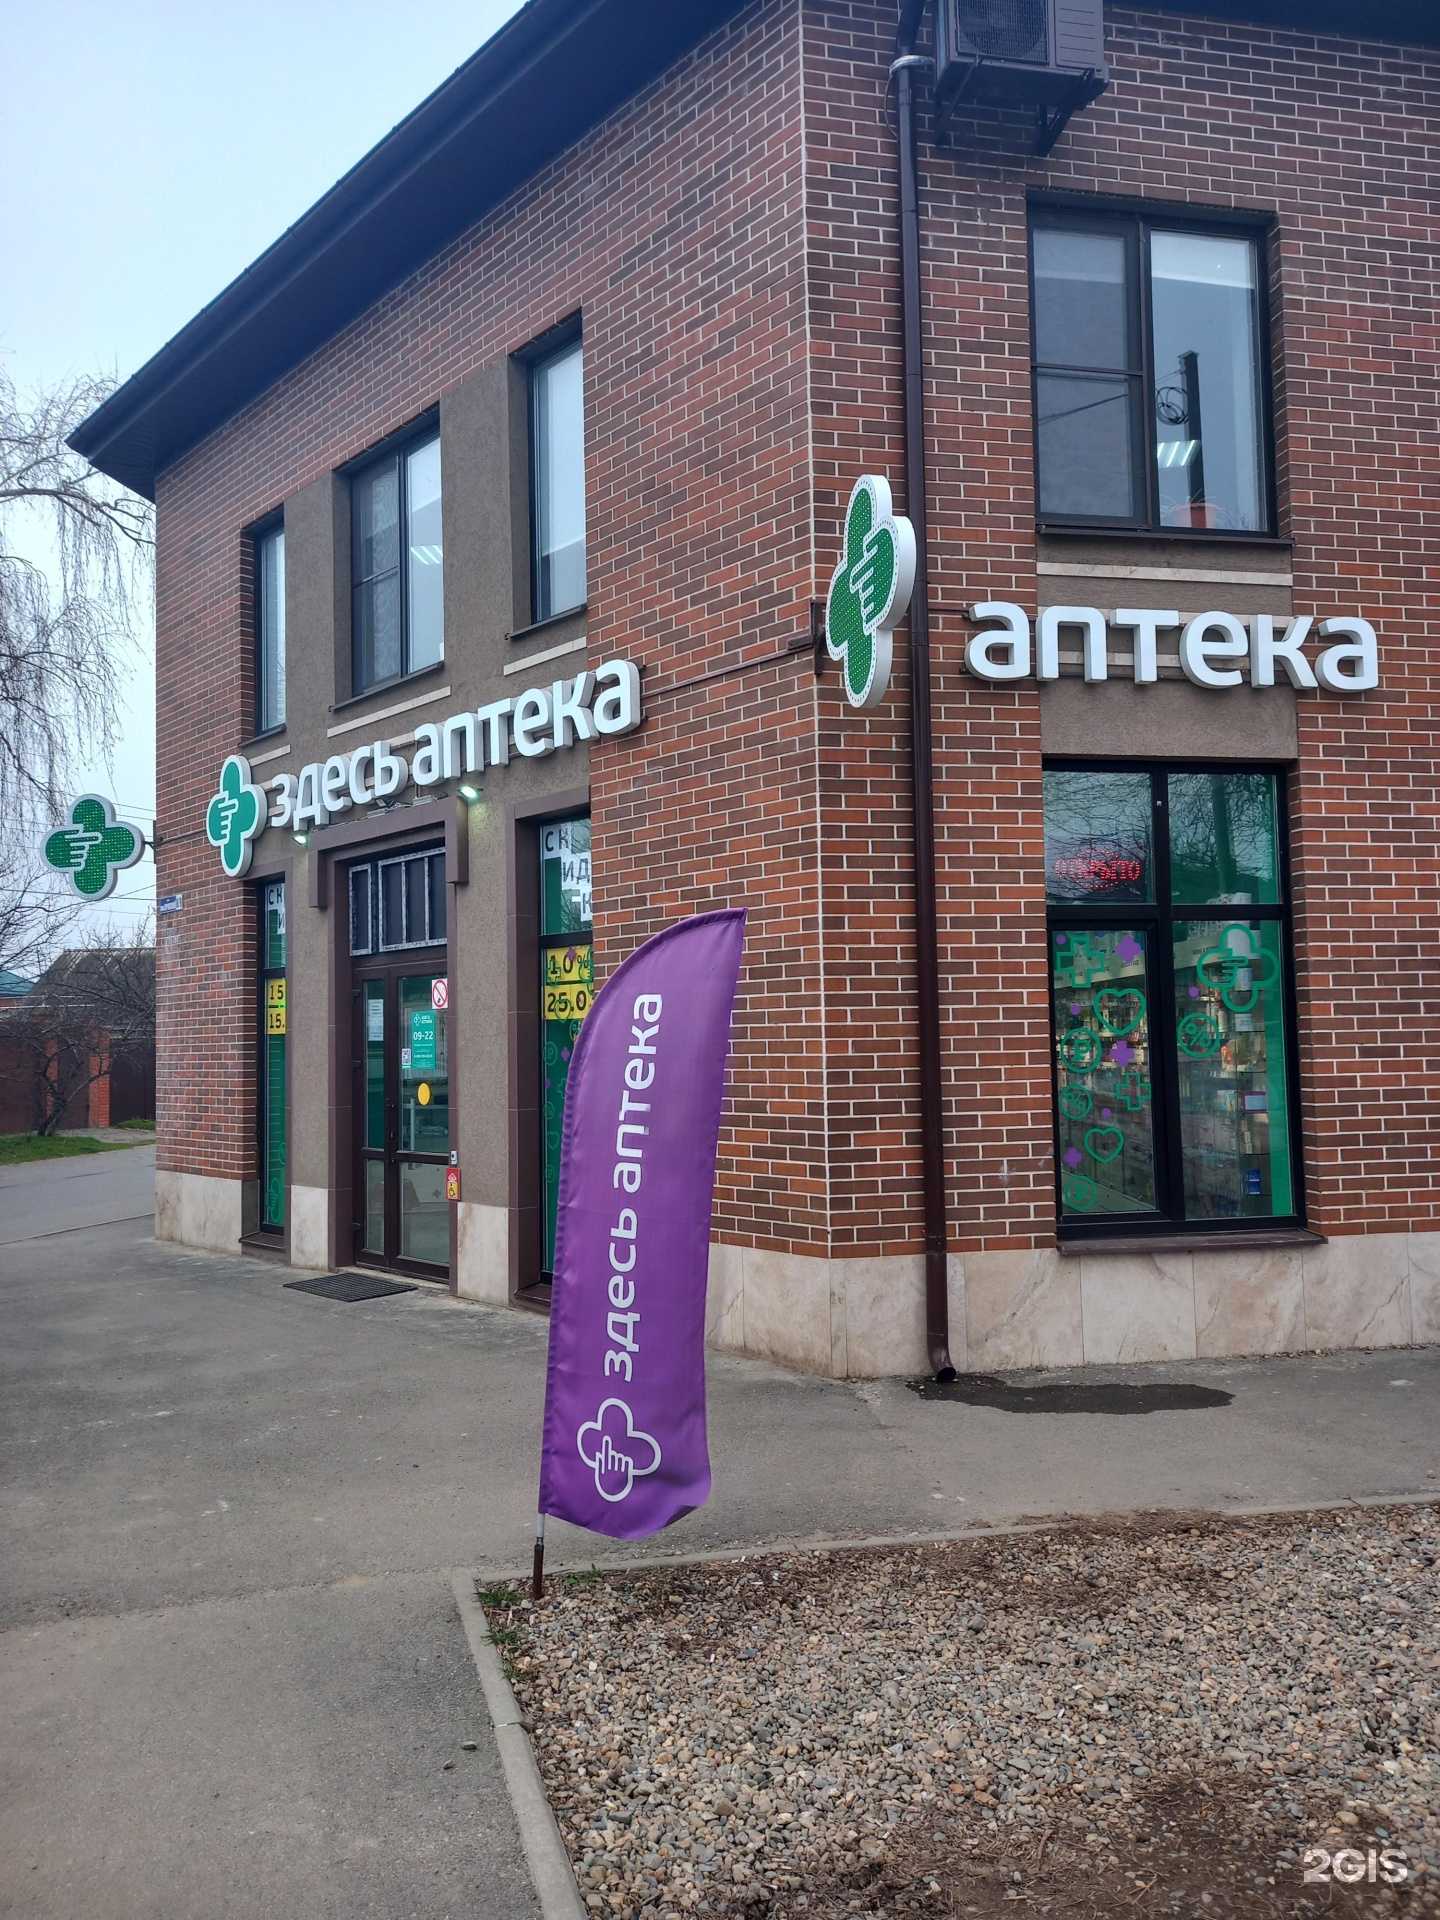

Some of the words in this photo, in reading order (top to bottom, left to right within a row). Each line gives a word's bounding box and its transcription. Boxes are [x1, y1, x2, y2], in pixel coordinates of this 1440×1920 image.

[964, 600, 1379, 694] аптека
[271, 740, 408, 831] здесь
[412, 658, 642, 787] аптека
[413, 1031, 434, 1041] 09-22
[613, 993, 663, 1194] аптека
[604, 1207, 641, 1382] здесь
